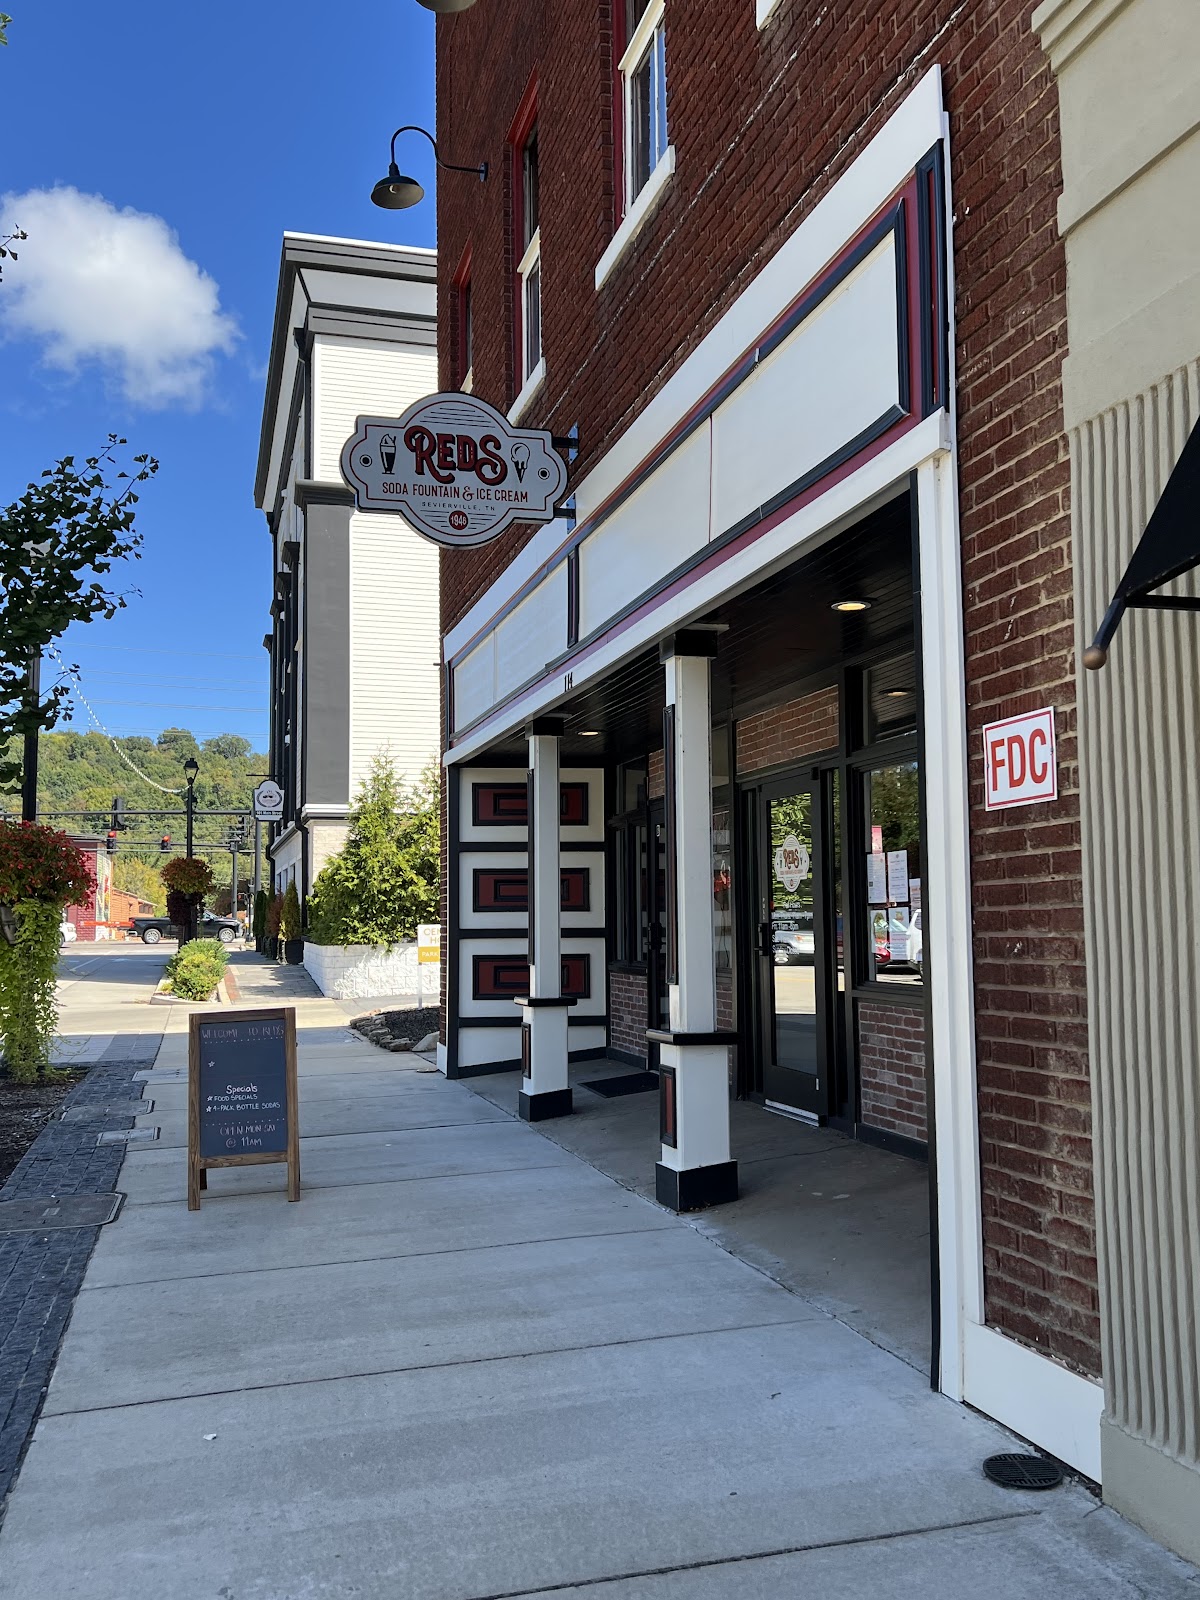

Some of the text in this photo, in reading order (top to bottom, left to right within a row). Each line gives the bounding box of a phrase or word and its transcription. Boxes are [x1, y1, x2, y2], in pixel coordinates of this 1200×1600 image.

[404, 425, 508, 486] REDS
[382, 481, 528, 503] SODA FOUNTAIN & ICE CREAM
[421, 501, 481, 511] SEVIERVILLE,
[990, 728, 1048, 791] FDC
[226, 1083, 258, 1095] Specials
[225, 1138, 237, 1148] @
